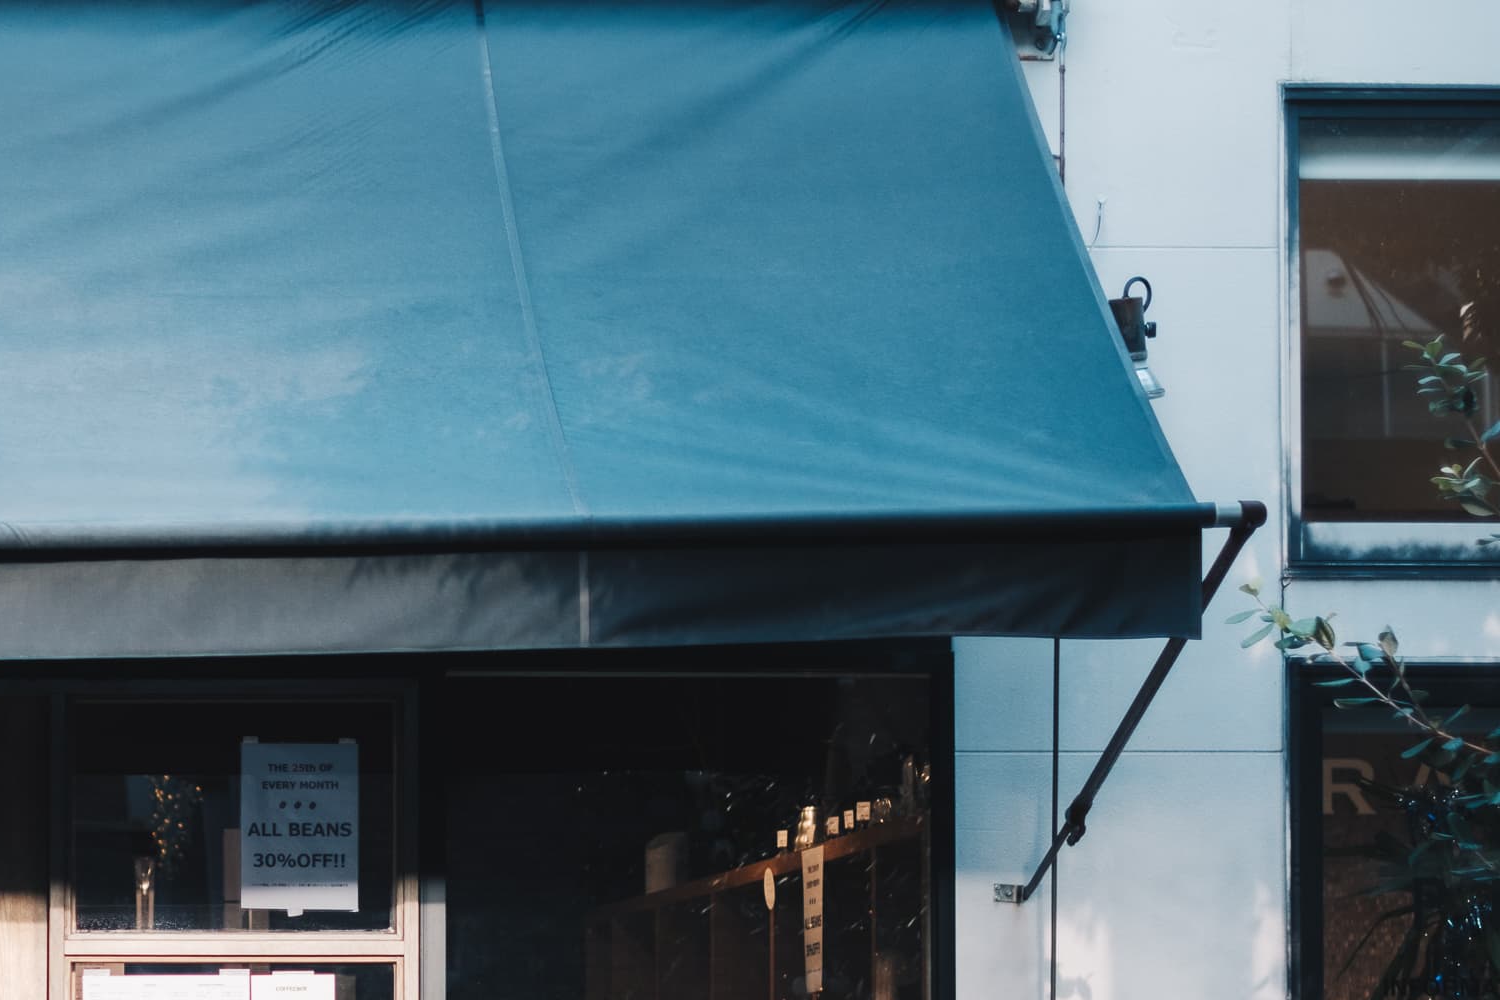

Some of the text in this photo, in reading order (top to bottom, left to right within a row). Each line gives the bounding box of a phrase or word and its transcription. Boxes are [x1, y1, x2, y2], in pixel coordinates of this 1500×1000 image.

[267, 763, 288, 773] THE
[261, 780, 339, 791] EVERY MONTH
[247, 822, 352, 838] ALL BEANS
[252, 852, 346, 869] 30%OFF!!
